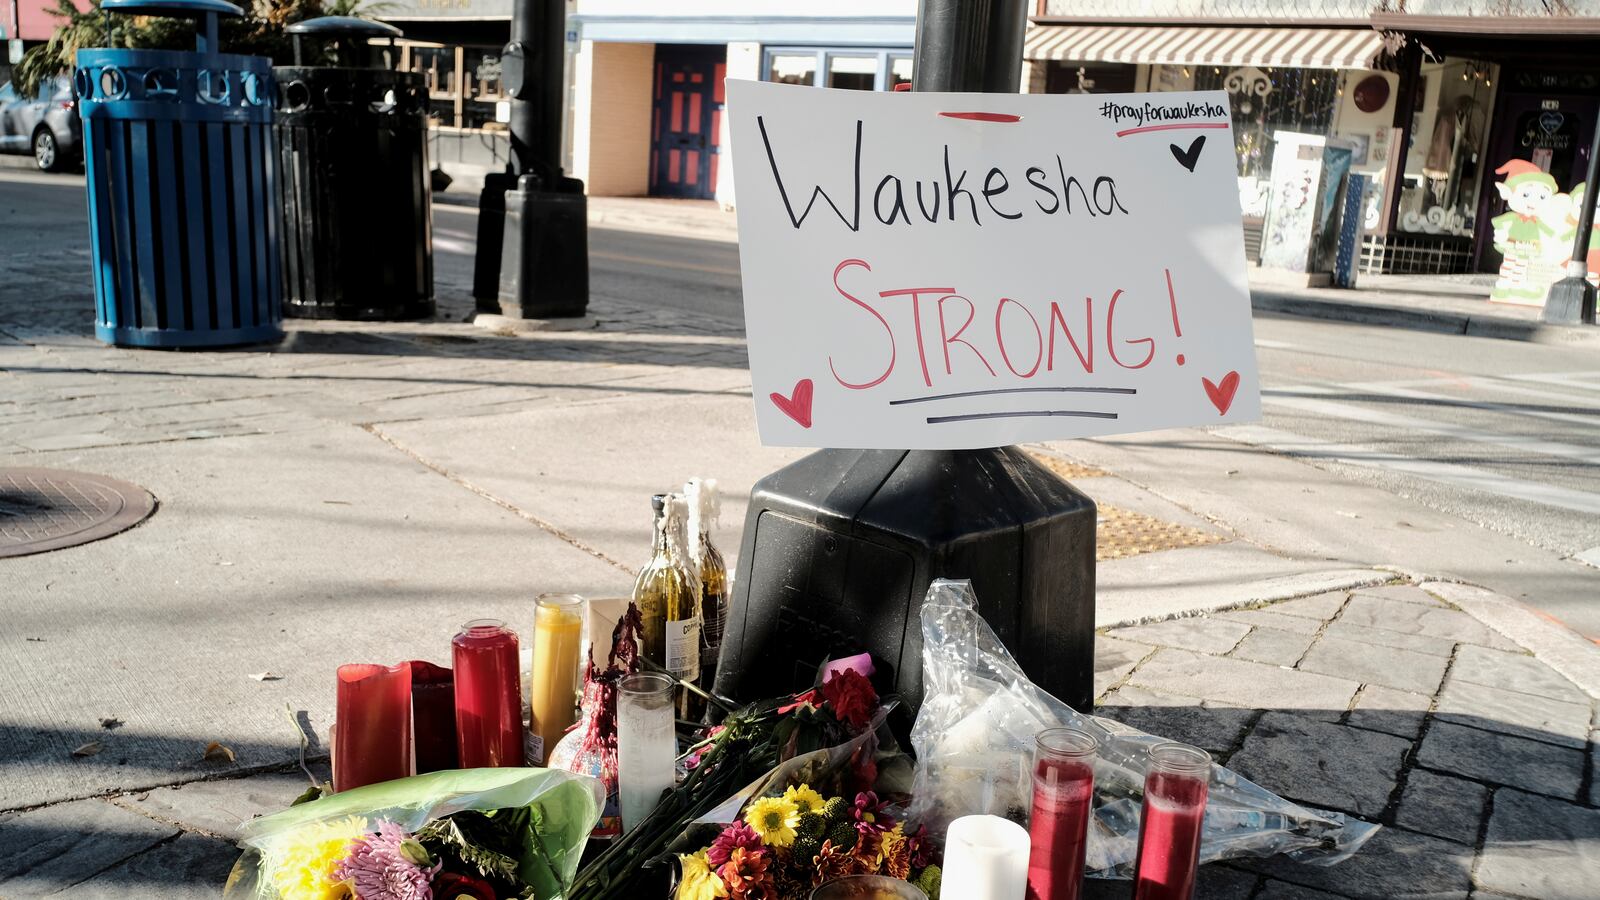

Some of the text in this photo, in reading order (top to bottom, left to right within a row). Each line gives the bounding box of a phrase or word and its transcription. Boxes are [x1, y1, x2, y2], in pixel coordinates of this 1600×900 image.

[1099, 102, 1227, 127] #prayforwaukesha
[757, 115, 1129, 232] Waukesha
[829, 258, 1186, 390] STRONG!
